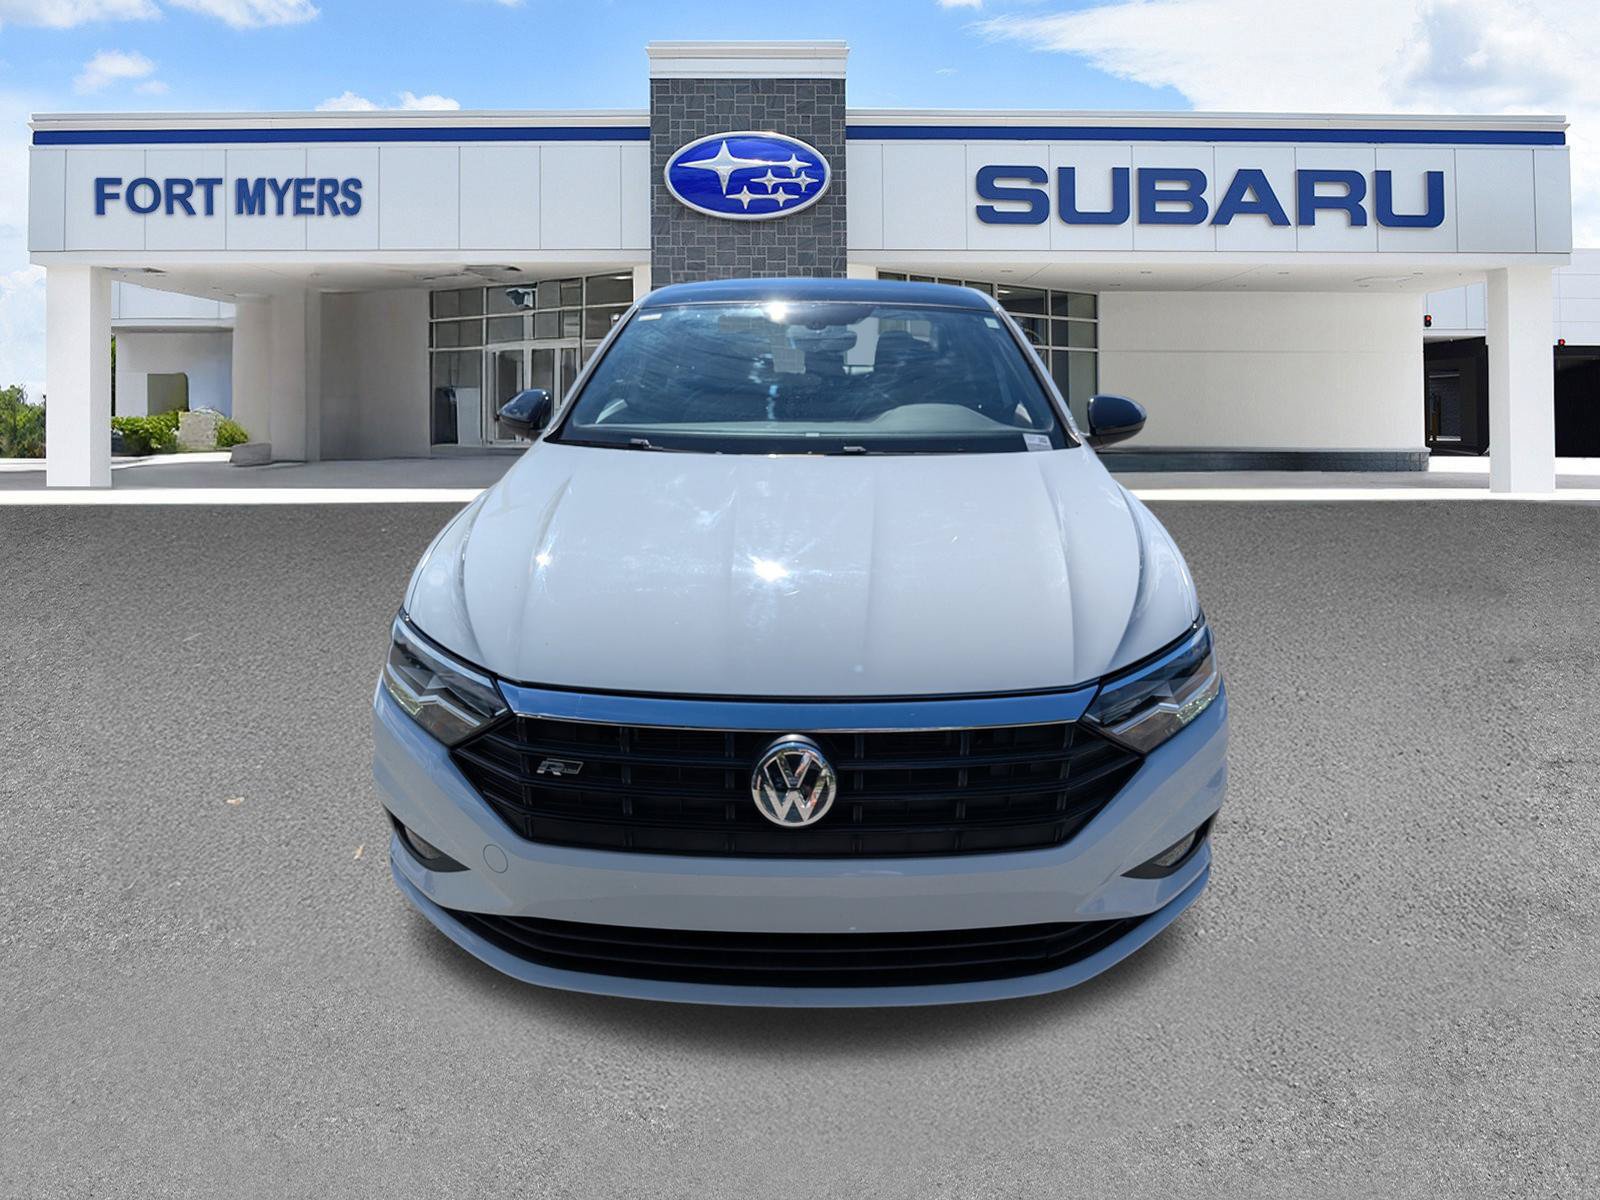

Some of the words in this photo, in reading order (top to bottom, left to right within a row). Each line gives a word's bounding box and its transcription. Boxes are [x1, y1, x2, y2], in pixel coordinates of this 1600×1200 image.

[94, 177, 223, 216] FORT
[235, 177, 363, 217] MYERS
[975, 164, 1446, 229] SUBARU
[755, 747, 834, 825] VW
